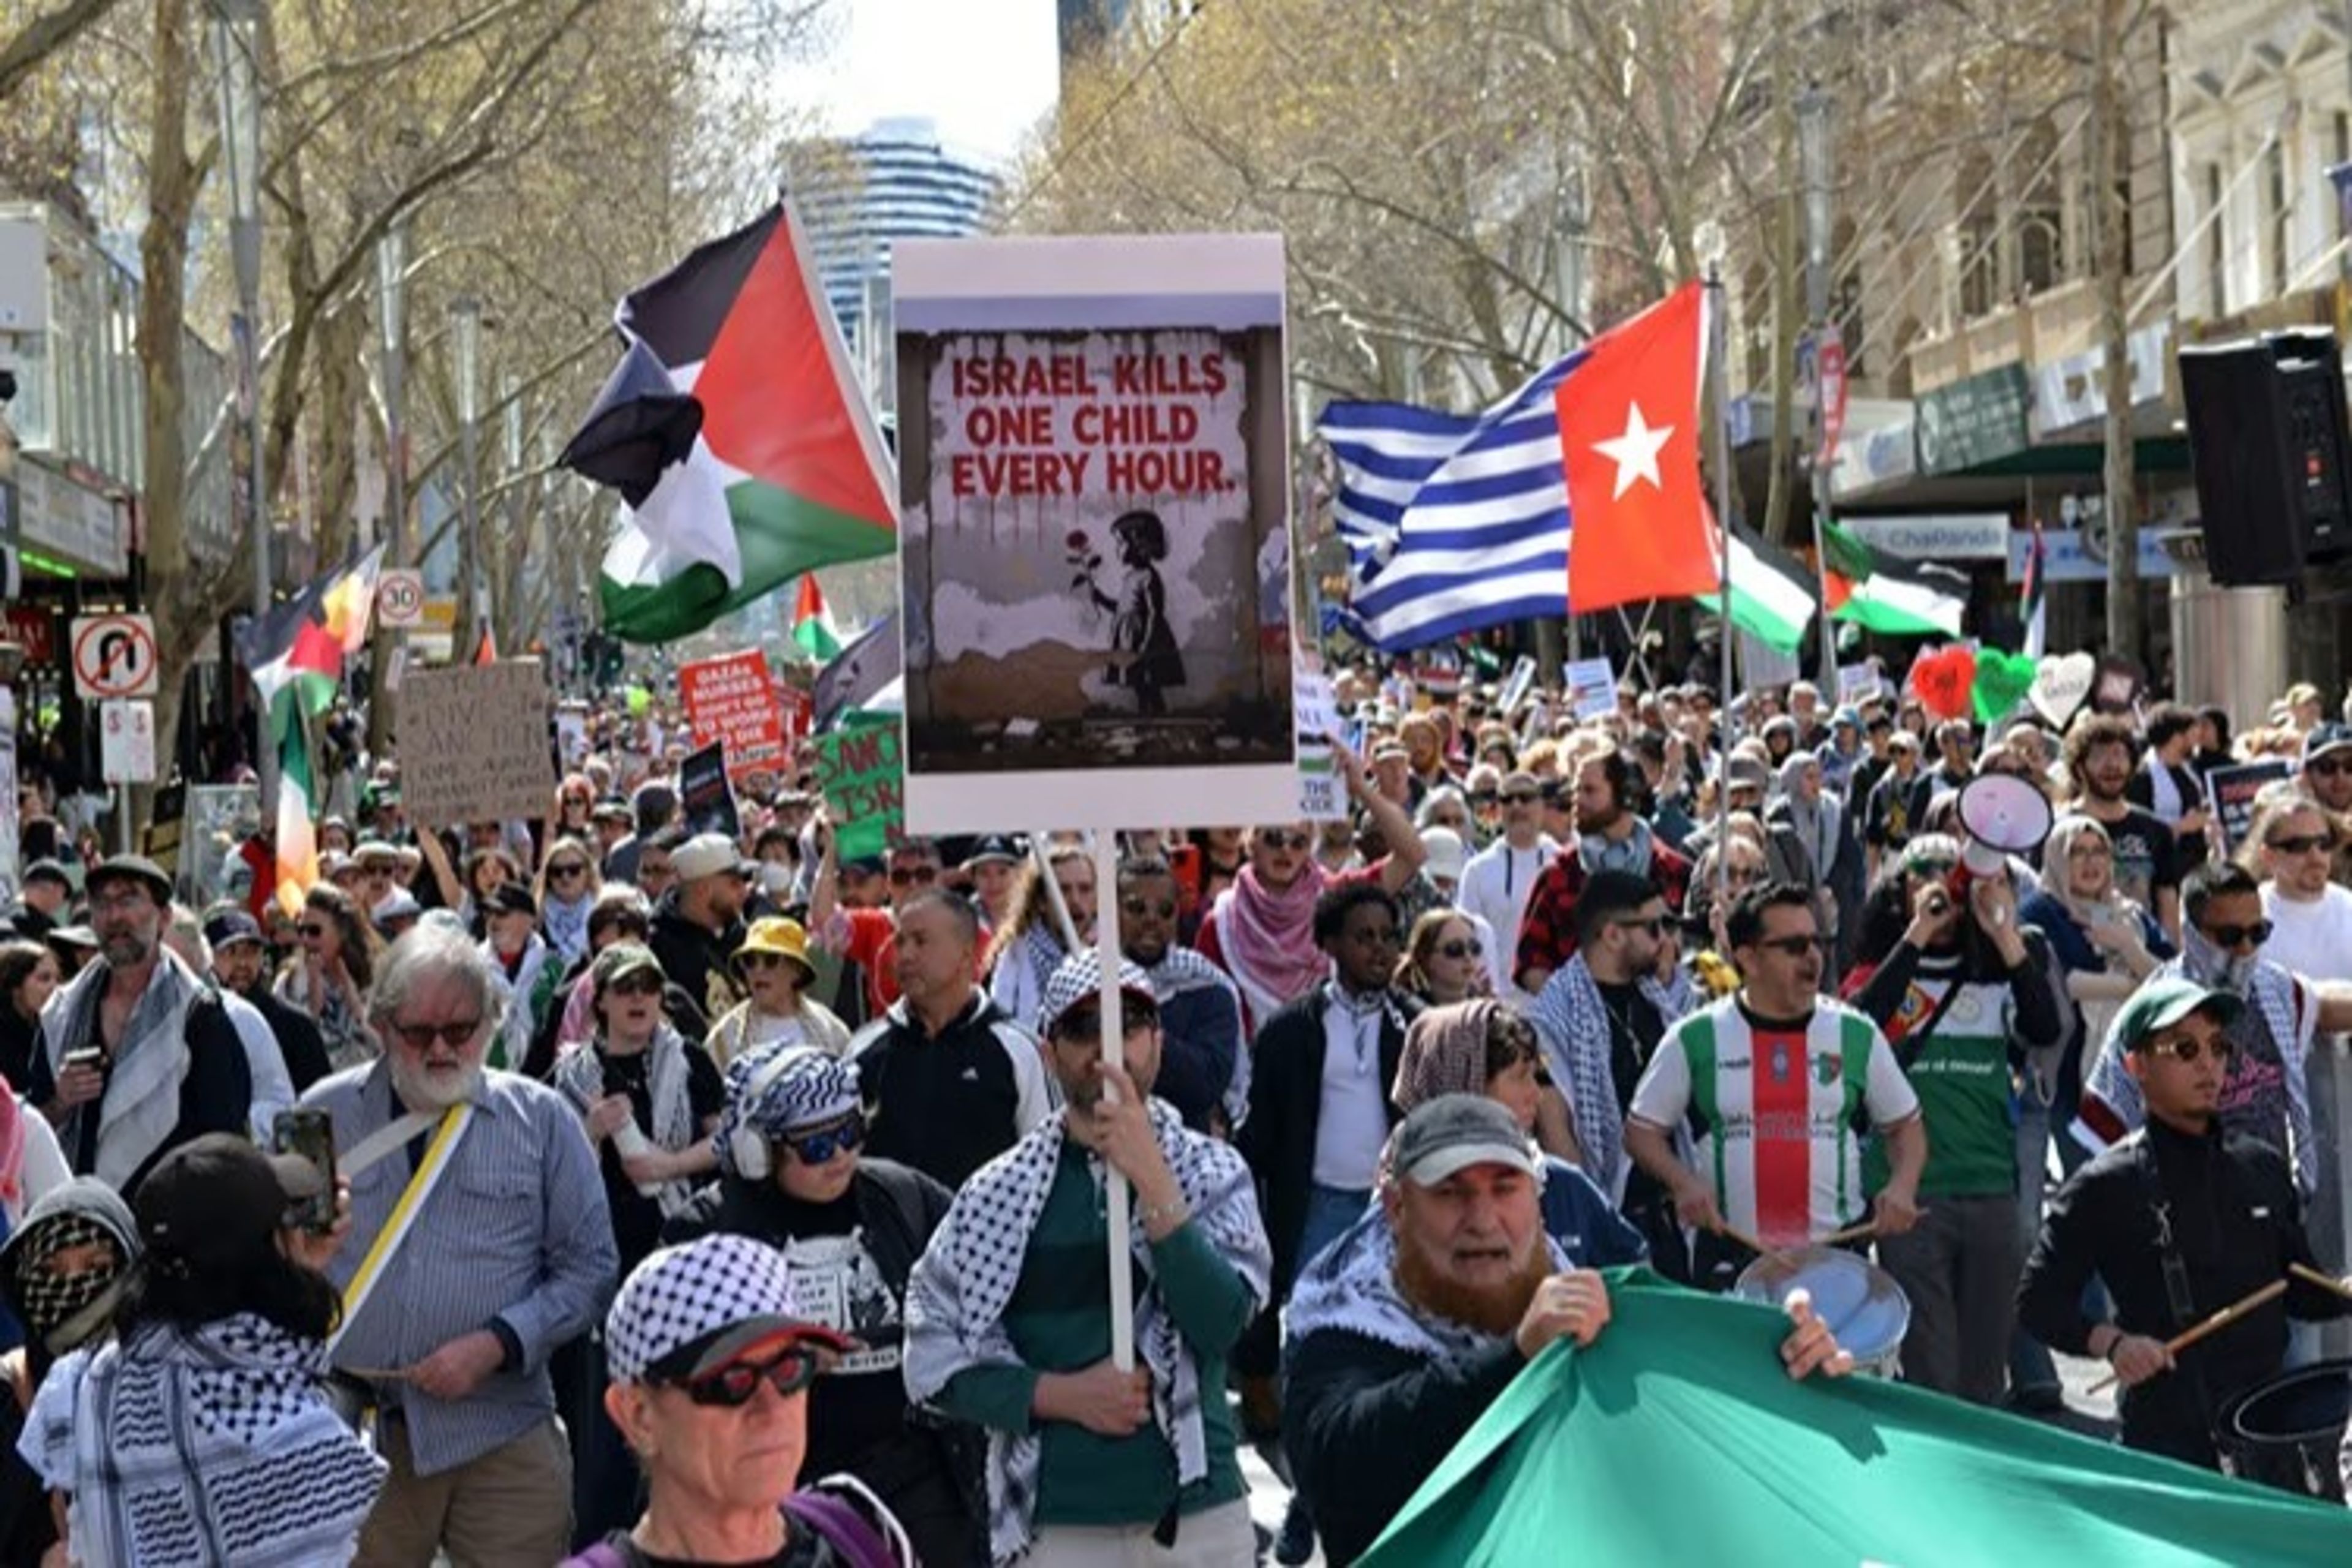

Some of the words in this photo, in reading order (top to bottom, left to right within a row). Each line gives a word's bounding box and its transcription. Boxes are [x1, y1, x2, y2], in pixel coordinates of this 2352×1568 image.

[952, 353, 1098, 398] ISRAEL
[1114, 352, 1227, 397] KILLS
[965, 405, 1054, 447] ONE
[1072, 402, 1198, 447] CHILD
[952, 453, 1090, 495] EVERY
[1107, 450, 1236, 492] HOUR.
[388, 587, 415, 607] 30
[693, 677, 763, 703] NURSES
[695, 720, 716, 735] TO
